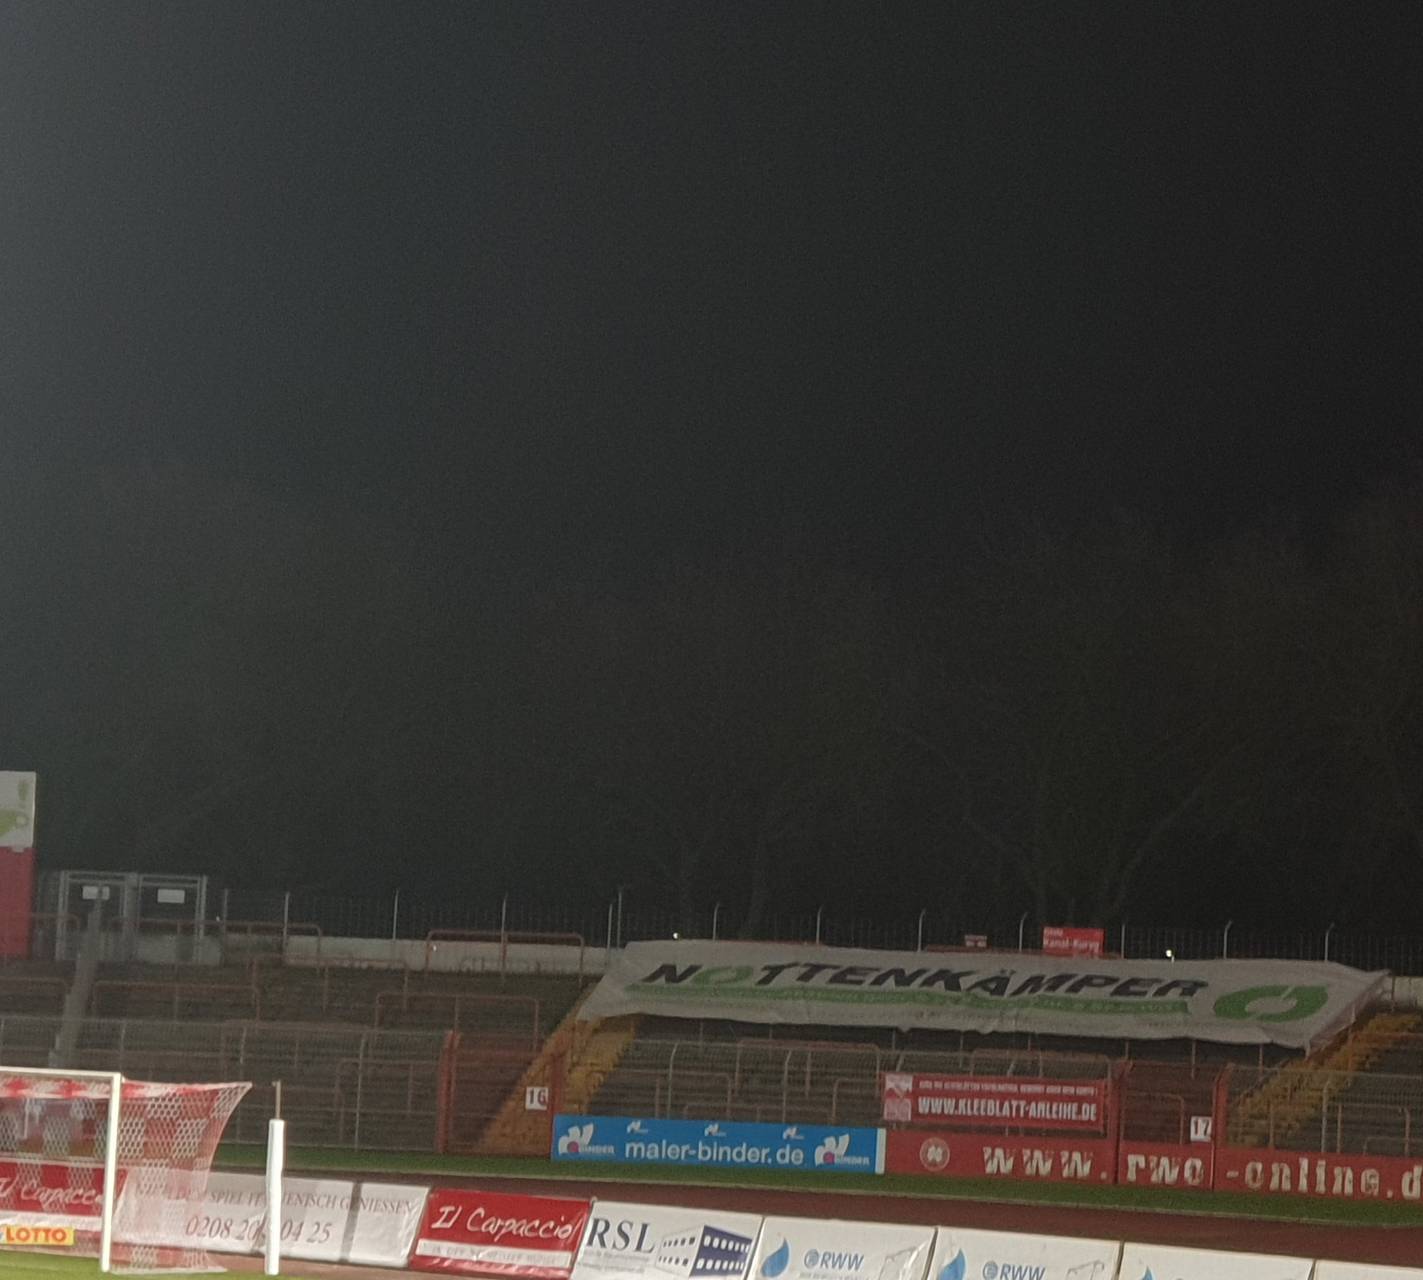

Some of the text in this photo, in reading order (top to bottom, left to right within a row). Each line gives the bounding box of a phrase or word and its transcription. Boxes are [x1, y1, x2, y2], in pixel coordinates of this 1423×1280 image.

[642, 962, 1208, 997] NOTTENKÄMPER
[529, 1088, 546, 1106] 16
[918, 1096, 1097, 1122] WWW.KLEEBLATT-ANLEIHE.DE
[1193, 1117, 1210, 1136] 17
[625, 1140, 804, 1165] maler-binder.de
[340, 1195, 413, 1213] GNIESSEN
[6, 1227, 67, 1242] LOTTO
[185, 1215, 231, 1237] 0208
[306, 1222, 333, 1243] 25
[586, 1217, 655, 1253] RSL
[820, 1250, 864, 1271] RWW
[1000, 1263, 1046, 1280] RWW
